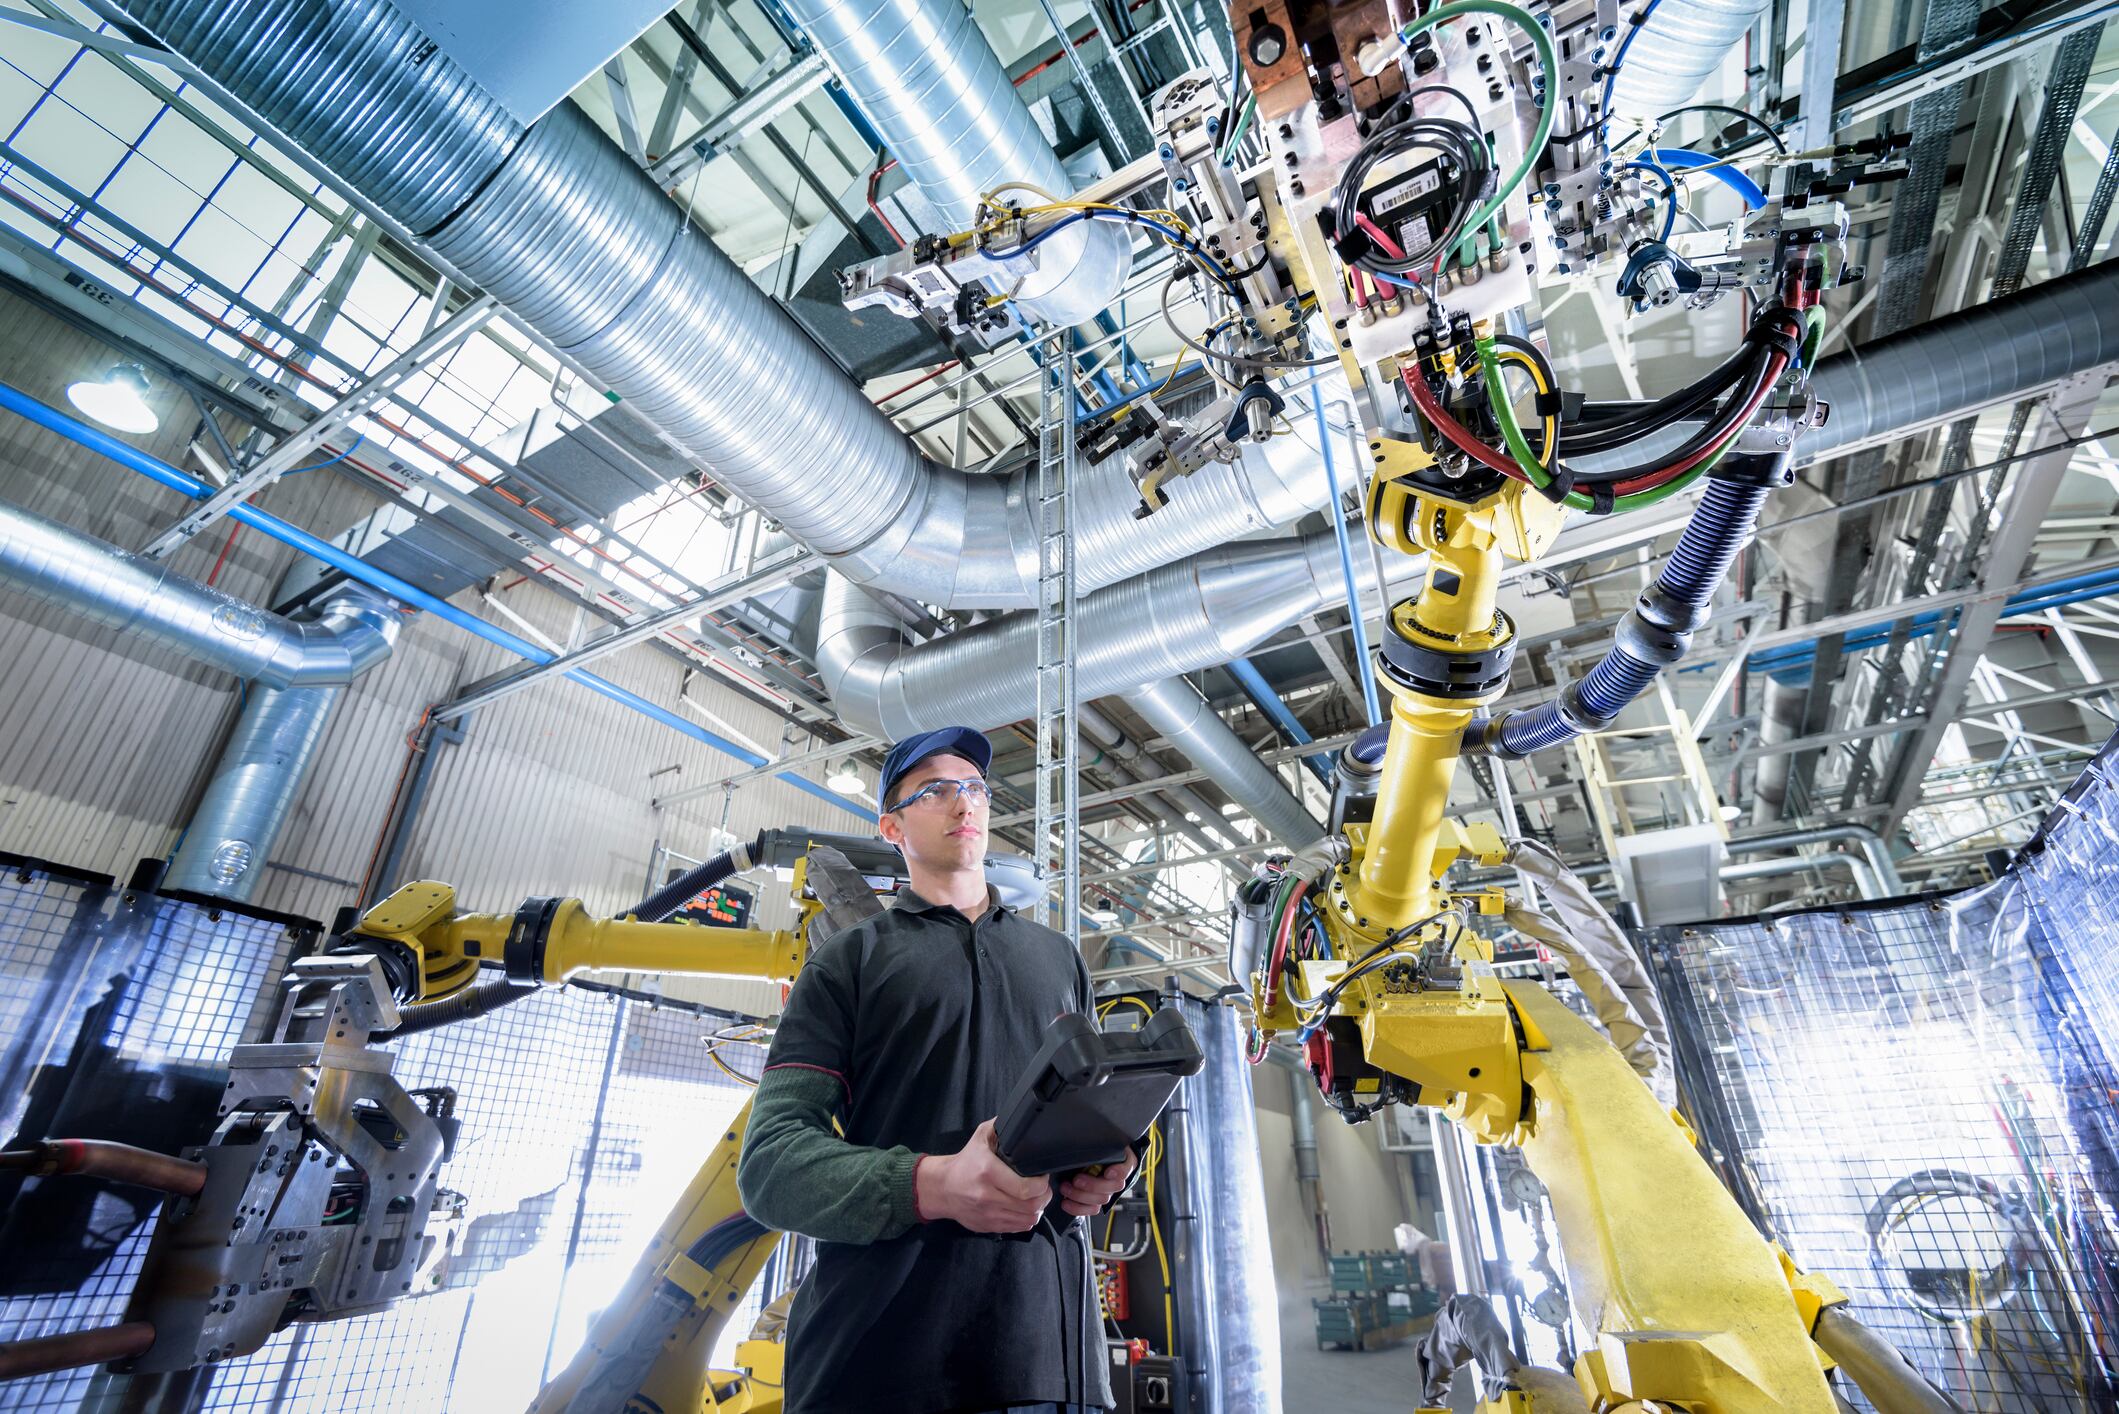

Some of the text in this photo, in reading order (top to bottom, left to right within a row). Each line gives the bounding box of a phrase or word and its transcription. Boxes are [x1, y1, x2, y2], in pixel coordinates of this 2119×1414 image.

[82, 283, 114, 304] 33
[258, 386, 280, 400] 31
[400, 468, 424, 483] 29
[517, 539, 537, 549] 27
